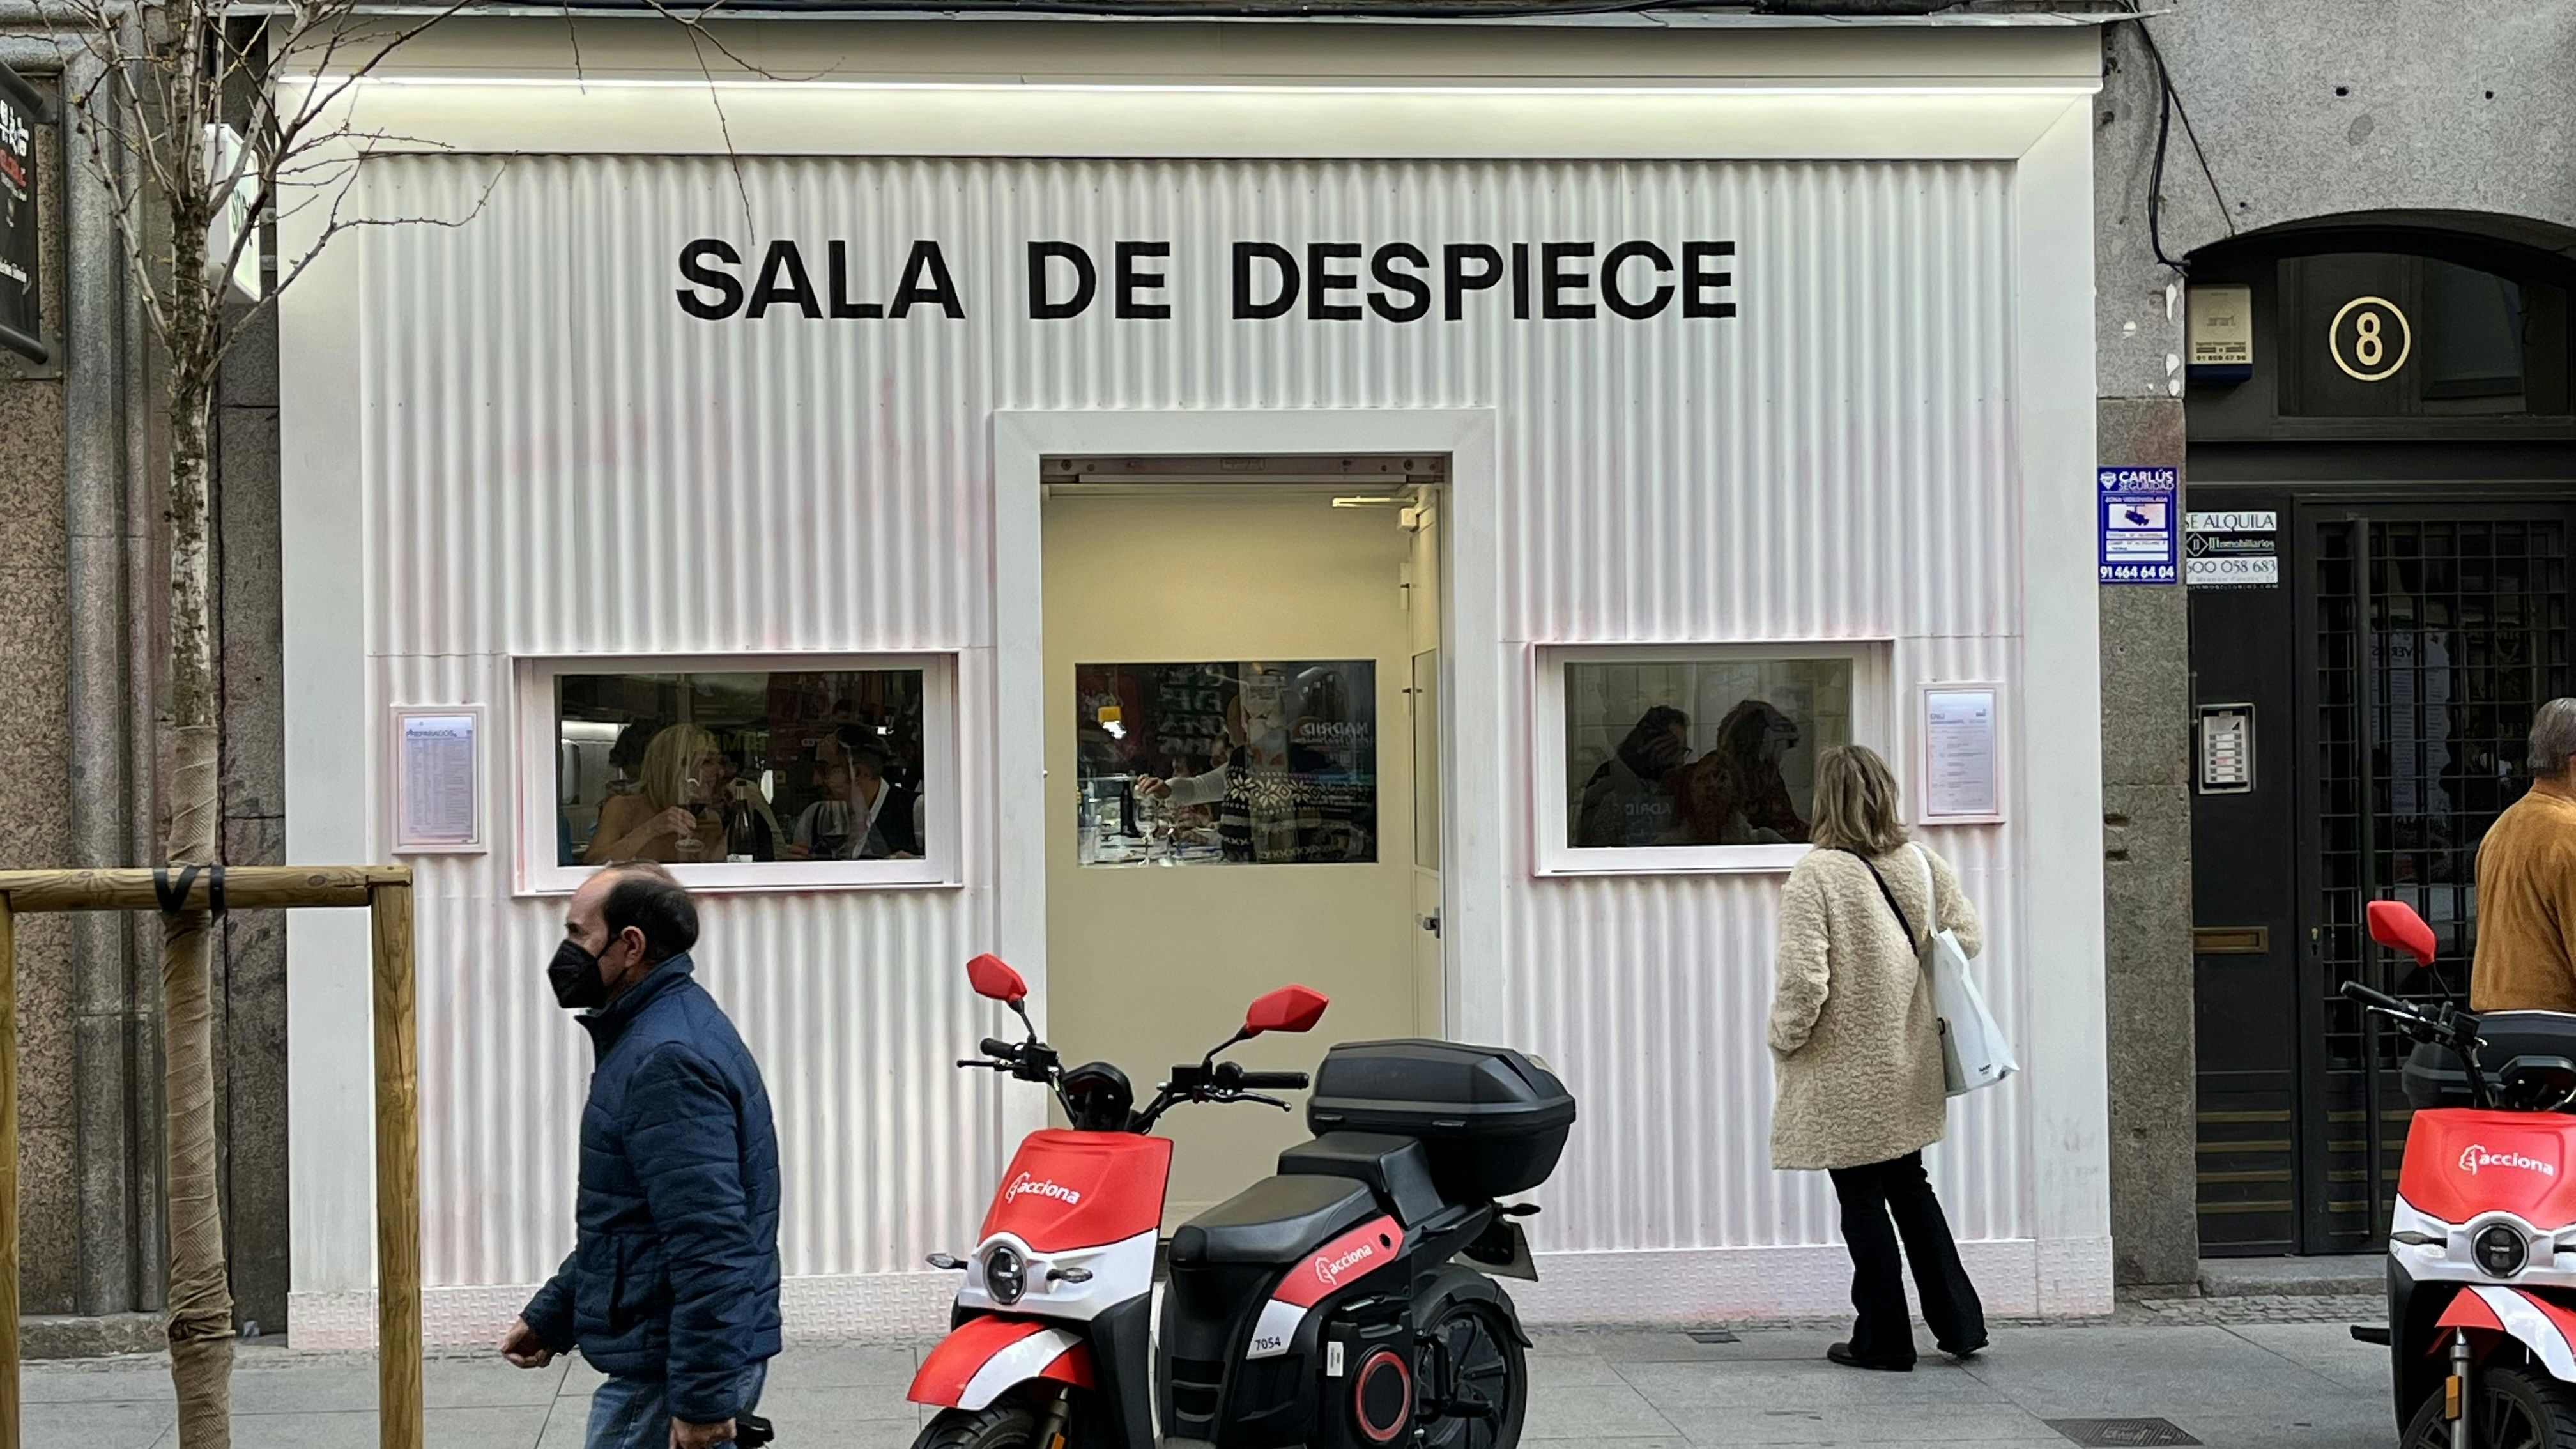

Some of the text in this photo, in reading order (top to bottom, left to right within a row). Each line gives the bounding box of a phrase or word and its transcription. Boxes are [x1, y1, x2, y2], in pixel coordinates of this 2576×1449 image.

[675, 238, 1736, 323] SALA DE DESPIECE
[2356, 312, 2383, 365] 8
[2119, 468, 2174, 482] CARLÚS
[2204, 514, 2275, 532] ALQUILA
[2100, 565, 2174, 578] 91 464 64 04
[2221, 560, 2248, 574] 058
[2253, 560, 2276, 574] 683
[2479, 1152, 2554, 1176] acciona
[1016, 1179, 1080, 1205] acciona
[1329, 1245, 1374, 1275] acciona
[1254, 1336, 1282, 1351] 7054
